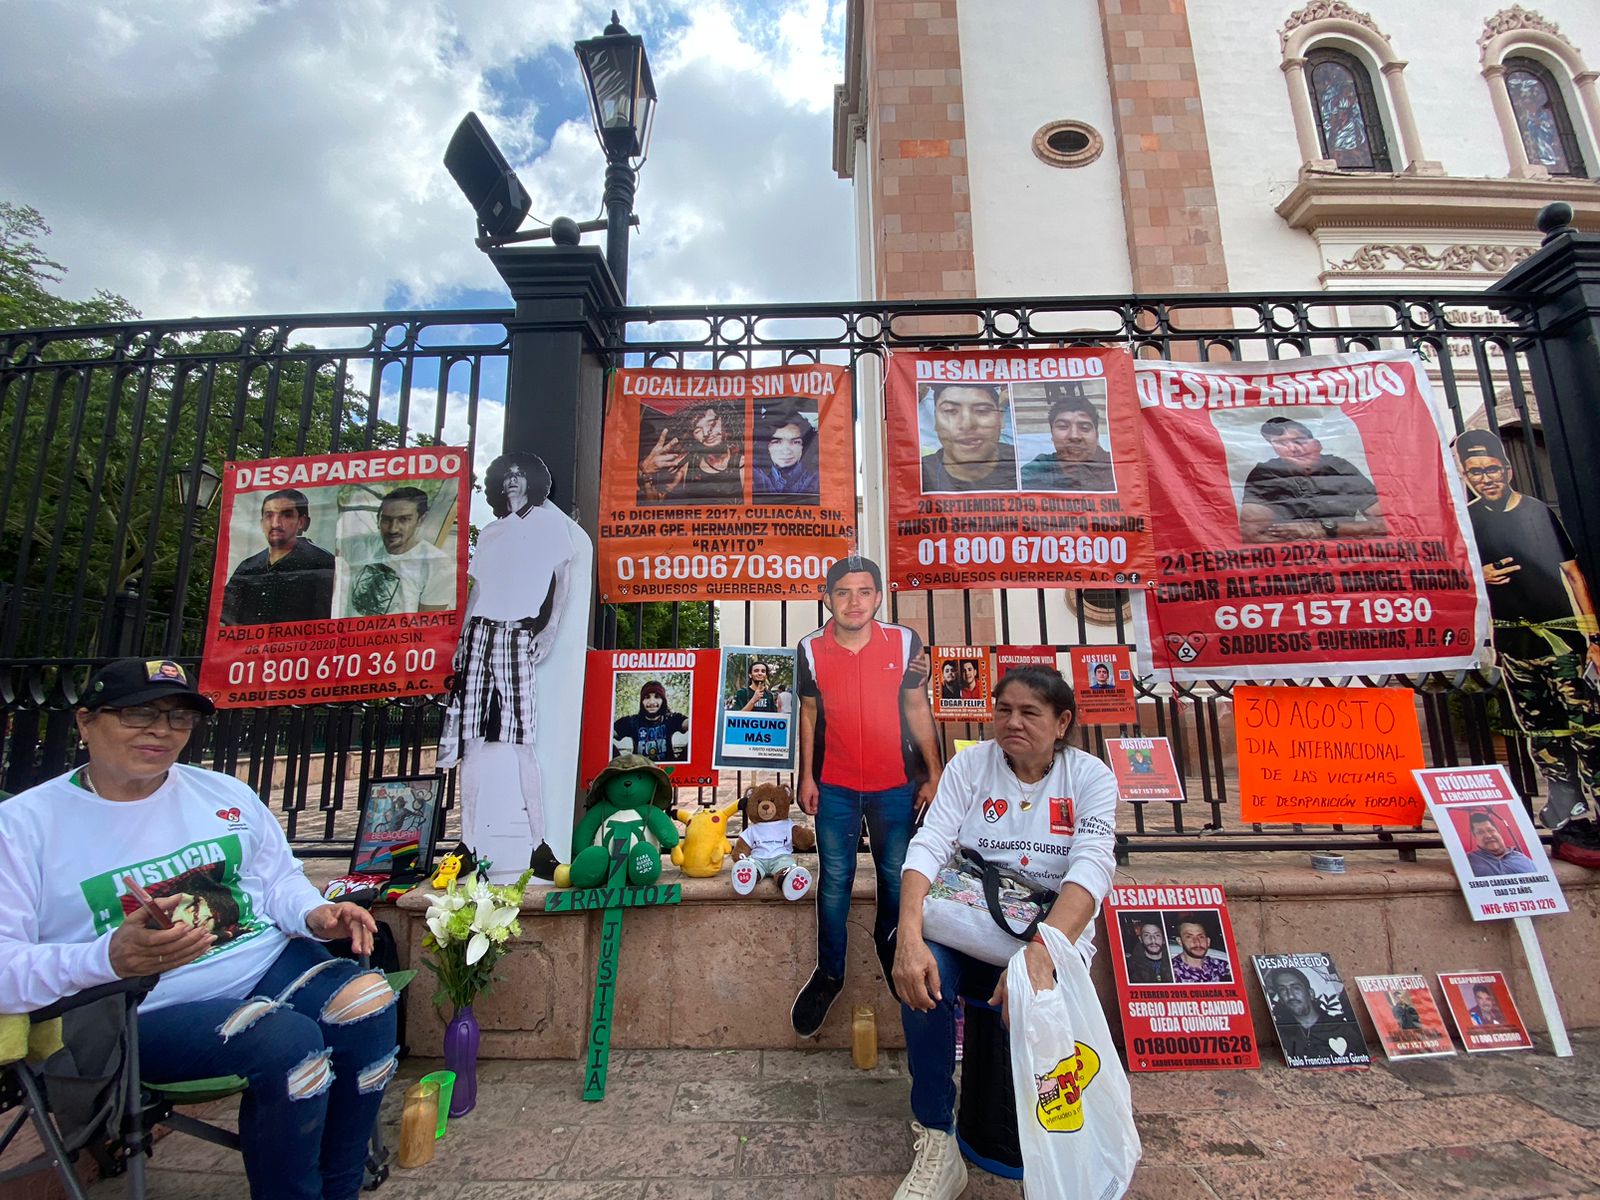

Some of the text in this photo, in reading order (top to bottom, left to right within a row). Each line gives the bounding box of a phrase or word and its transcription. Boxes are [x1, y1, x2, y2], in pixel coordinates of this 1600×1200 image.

[916, 356, 1104, 380] DESAPARECIDO
[622, 371, 835, 397] LOCALIZADO SIN VIDA
[1136, 363, 1405, 410] DESAPARECIDO
[236, 454, 461, 490] DESAPARECIDO
[610, 507, 845, 521] 16 DICIEMBRE 2017, CULIACÁN, SIN.
[918, 500, 932, 514] 20
[936, 498, 1005, 514] SEPTIEMBRE
[1100, 498, 1124, 512] SIN.
[601, 522, 854, 538] ELEAZAR GPE. HERNANDEZ TORRECILLAS
[898, 516, 948, 536] FAUSTO
[952, 516, 1018, 534] BENJAMIN
[1022, 516, 1088, 532] SOBAMPO
[918, 536, 1126, 566] 01 800 6703600
[1162, 555, 1187, 576] 24
[1190, 547, 1276, 572] FEBRERO
[1280, 544, 1328, 566] 2024
[1336, 540, 1420, 564] CULIACÁN
[924, 572, 996, 584] SABUESOS
[1000, 572, 1084, 583] GUERRERAS,
[1157, 568, 1470, 604] EDGAR ALEJANDRO RANGEL MACIAS
[632, 584, 812, 595] SABUESOS GUERRERAS, A.C.
[1214, 597, 1432, 630] 667 157 1930
[218, 613, 456, 641] PABLO FRANCISCO LOAIZA GARATE
[262, 642, 308, 654] AGOSTO
[401, 632, 425, 644] SIN.
[1218, 628, 1440, 655] SABUESOS GUERRERAS, A.C.
[612, 652, 696, 669] LOCALIZADO
[938, 648, 983, 658] JUSTICIA
[1081, 654, 1118, 663] JUSTICIA
[228, 648, 436, 684] 01 800 670 36 00
[228, 679, 434, 704] SABUESOS GUERRERAS, A.C.
[728, 718, 786, 730] NINGUNO
[1246, 698, 1395, 734] 30 AGOSTO
[744, 731, 772, 743] MÁS
[1120, 739, 1154, 750] JUSTICIA
[1246, 738, 1406, 762] DIA INTERNACIONAL
[1261, 767, 1397, 784] DE LAS VICTIMAS
[1434, 773, 1496, 791] AYÚDAME
[1252, 794, 1417, 808] DE DESAPARICIÓN FORZADA
[1441, 789, 1503, 802] A ENCONTRARLO
[978, 838, 988, 848] SG
[990, 840, 1031, 851] SABUESOS
[112, 842, 226, 897] JUSTICIA
[571, 886, 658, 910] RAYITO
[1109, 887, 1223, 906] DESAPARECIDO
[1481, 898, 1556, 915] INFO: 667 573 1276
[1258, 957, 1330, 969] DESAPARECIDO
[1360, 976, 1426, 993] DESAPARECIDO
[1449, 975, 1496, 984] DESAPARECIDO
[1130, 991, 1138, 999] 22
[1140, 990, 1170, 999] FEBRERO
[586, 922, 618, 1092] JUSTICIA
[1128, 1000, 1245, 1017] SERGIO JAVIER CANDIDO
[1150, 1017, 1180, 1032] OJEDA
[1134, 1036, 1252, 1055] 01800077628
[1287, 1056, 1304, 1066] Pablo
[1304, 1055, 1331, 1065] Francisco
[1330, 1054, 1350, 1064] Loaiza
